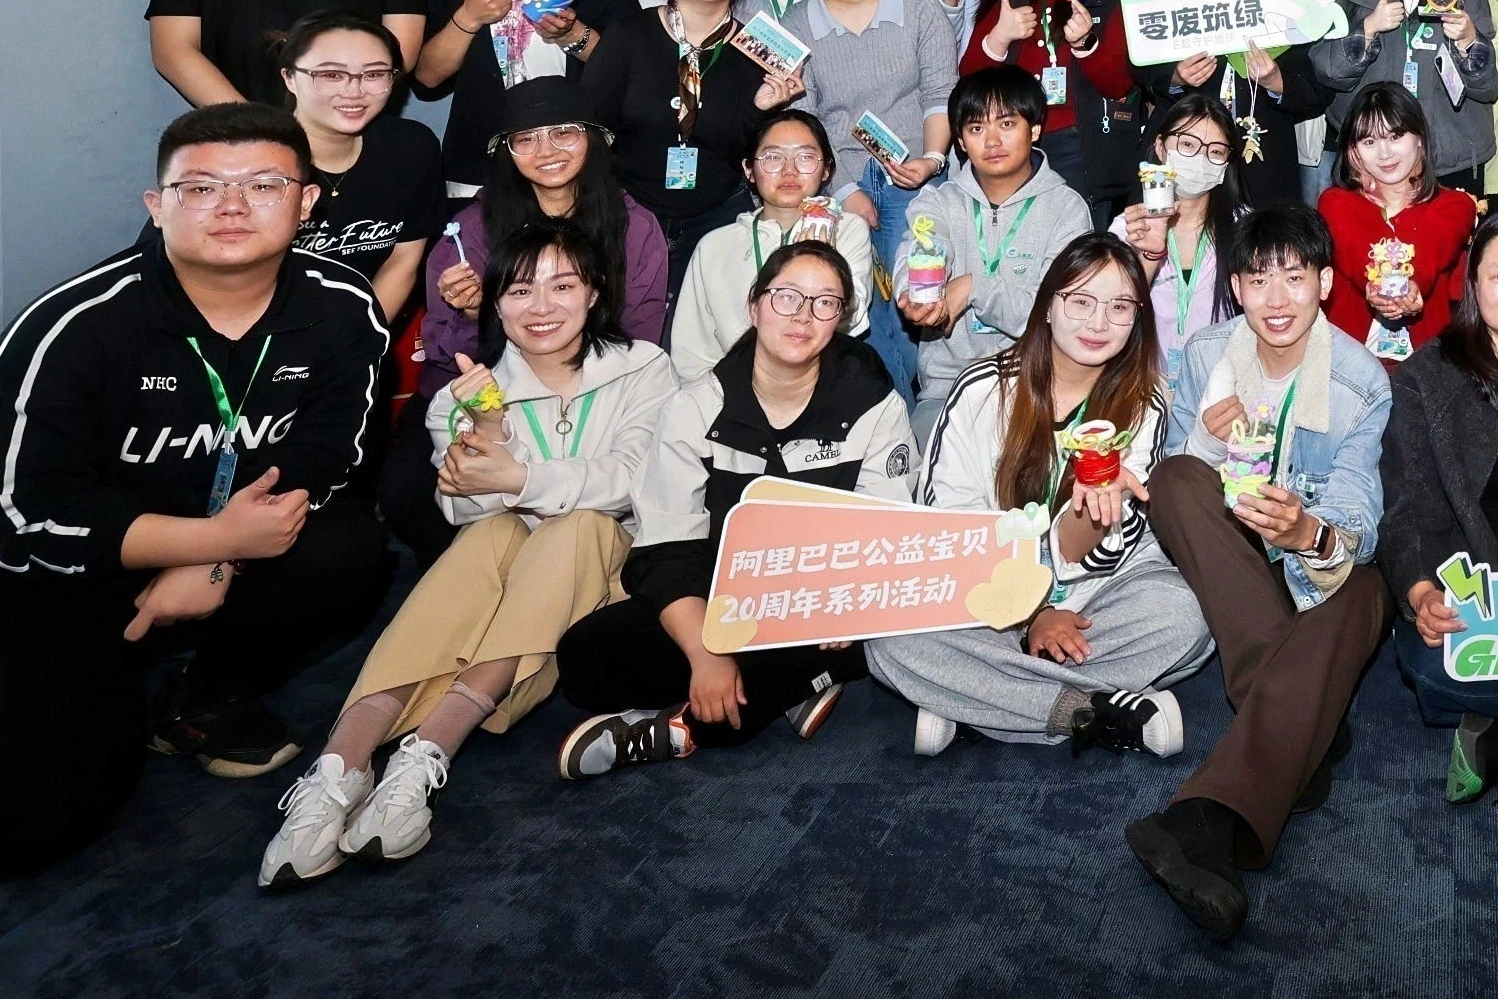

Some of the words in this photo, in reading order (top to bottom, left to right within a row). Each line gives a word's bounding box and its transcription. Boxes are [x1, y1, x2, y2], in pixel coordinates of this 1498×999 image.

[340, 219, 404, 250] Future
[141, 377, 177, 391] NHC
[271, 372, 310, 382] LI-NING
[805, 449, 841, 463] CAMEL
[728, 526, 989, 580] 阿里巴巴公益宝贝
[720, 575, 957, 623] 20周年系列活动
